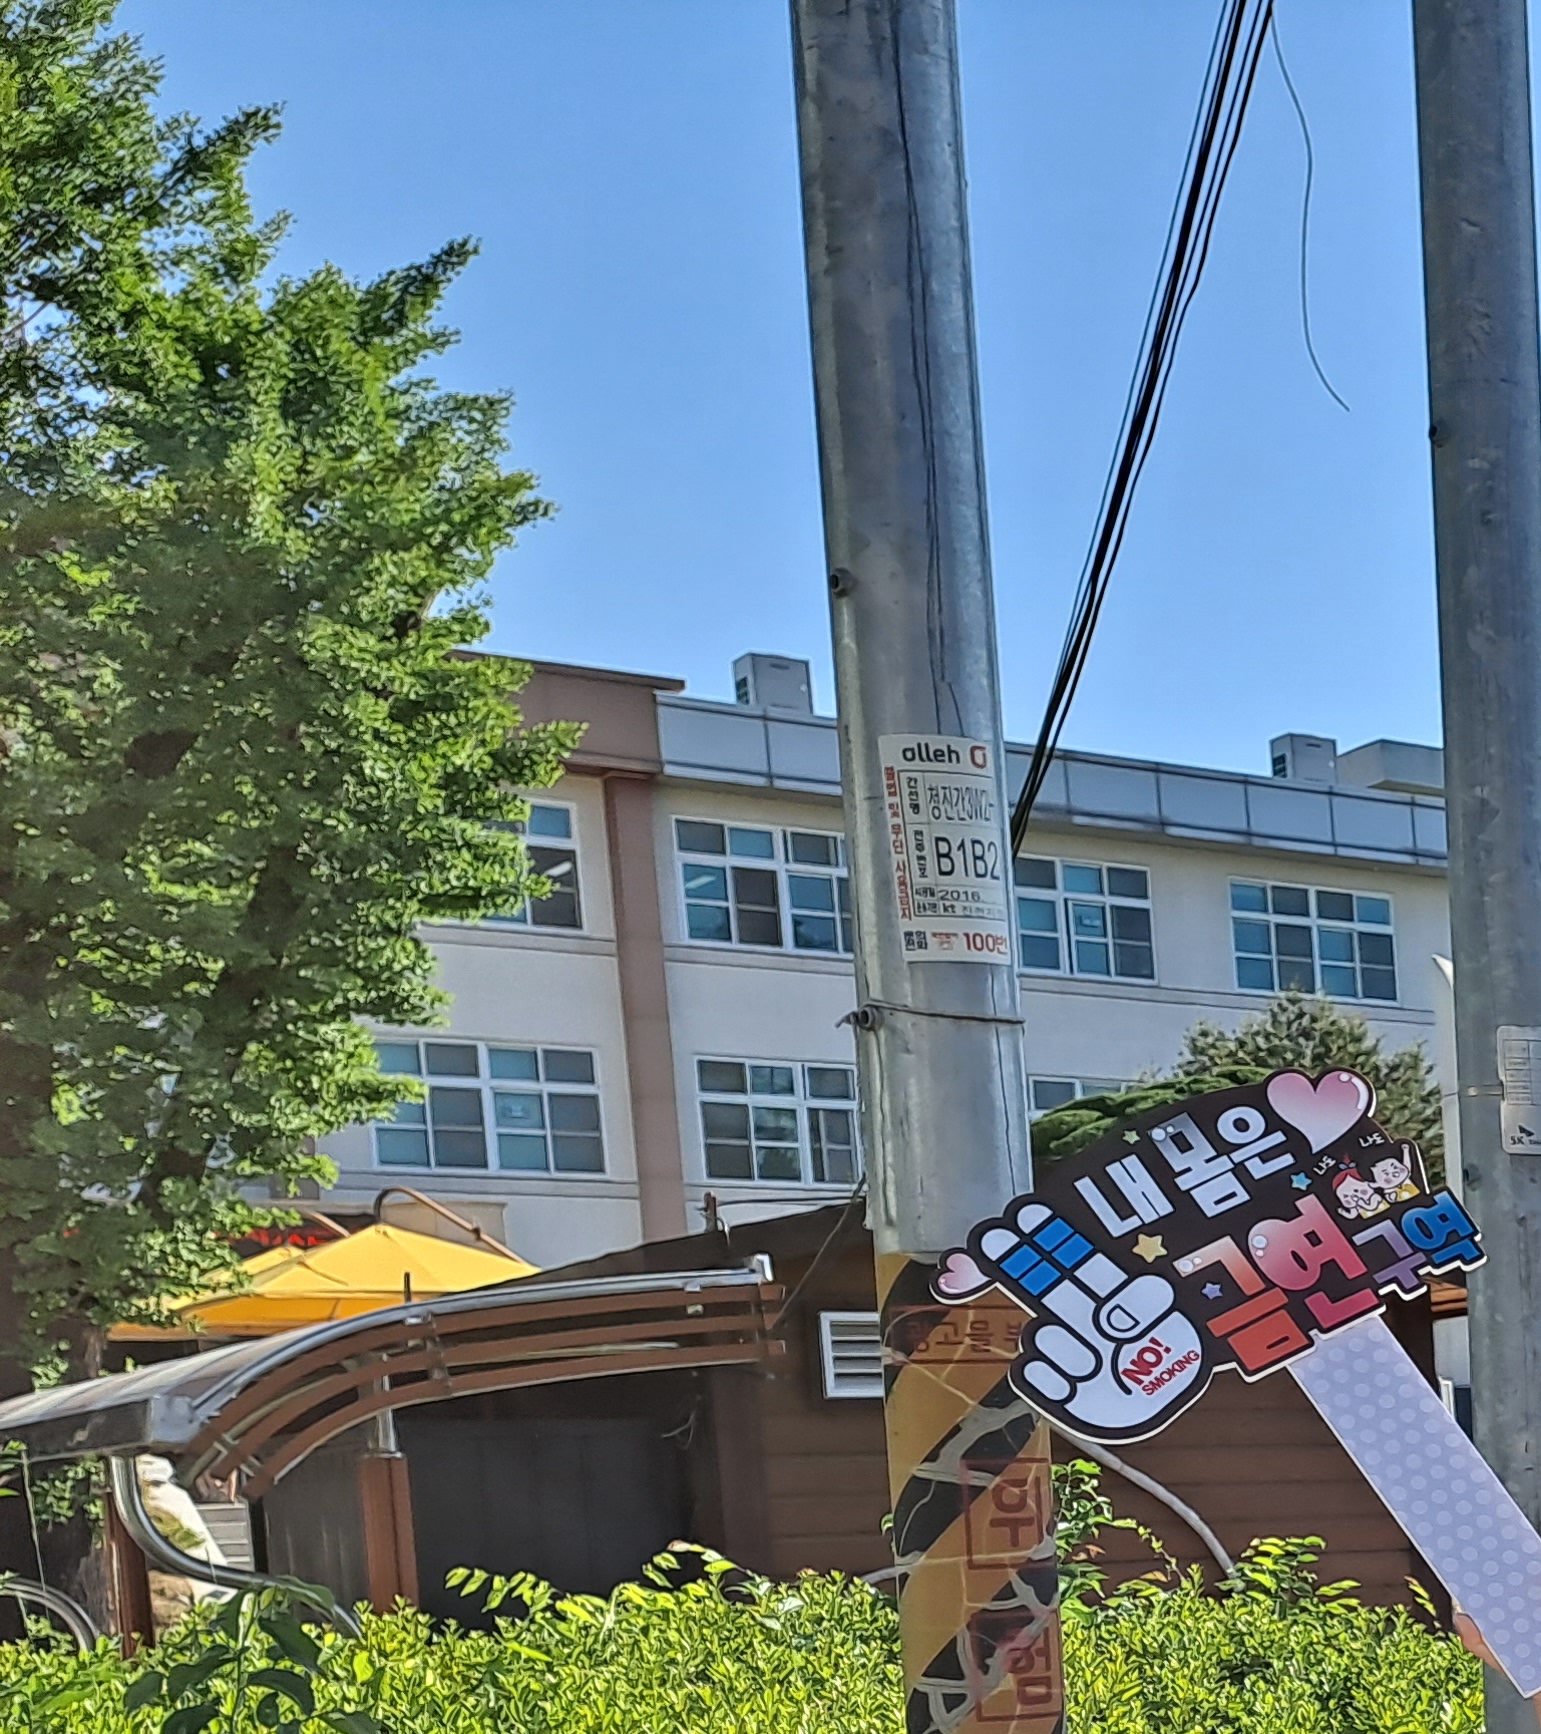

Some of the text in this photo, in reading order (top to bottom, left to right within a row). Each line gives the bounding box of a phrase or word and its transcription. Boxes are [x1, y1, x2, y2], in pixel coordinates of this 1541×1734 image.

[902, 742, 961, 764] olleh
[934, 836, 1000, 881] B1B2
[1359, 1130, 1386, 1150] 나도
[1073, 1104, 1298, 1238] 내 몸은
[1312, 1153, 1336, 1178] 나도
[1120, 1336, 1172, 1386] NO!
[1141, 1349, 1200, 1396] SMOKING
